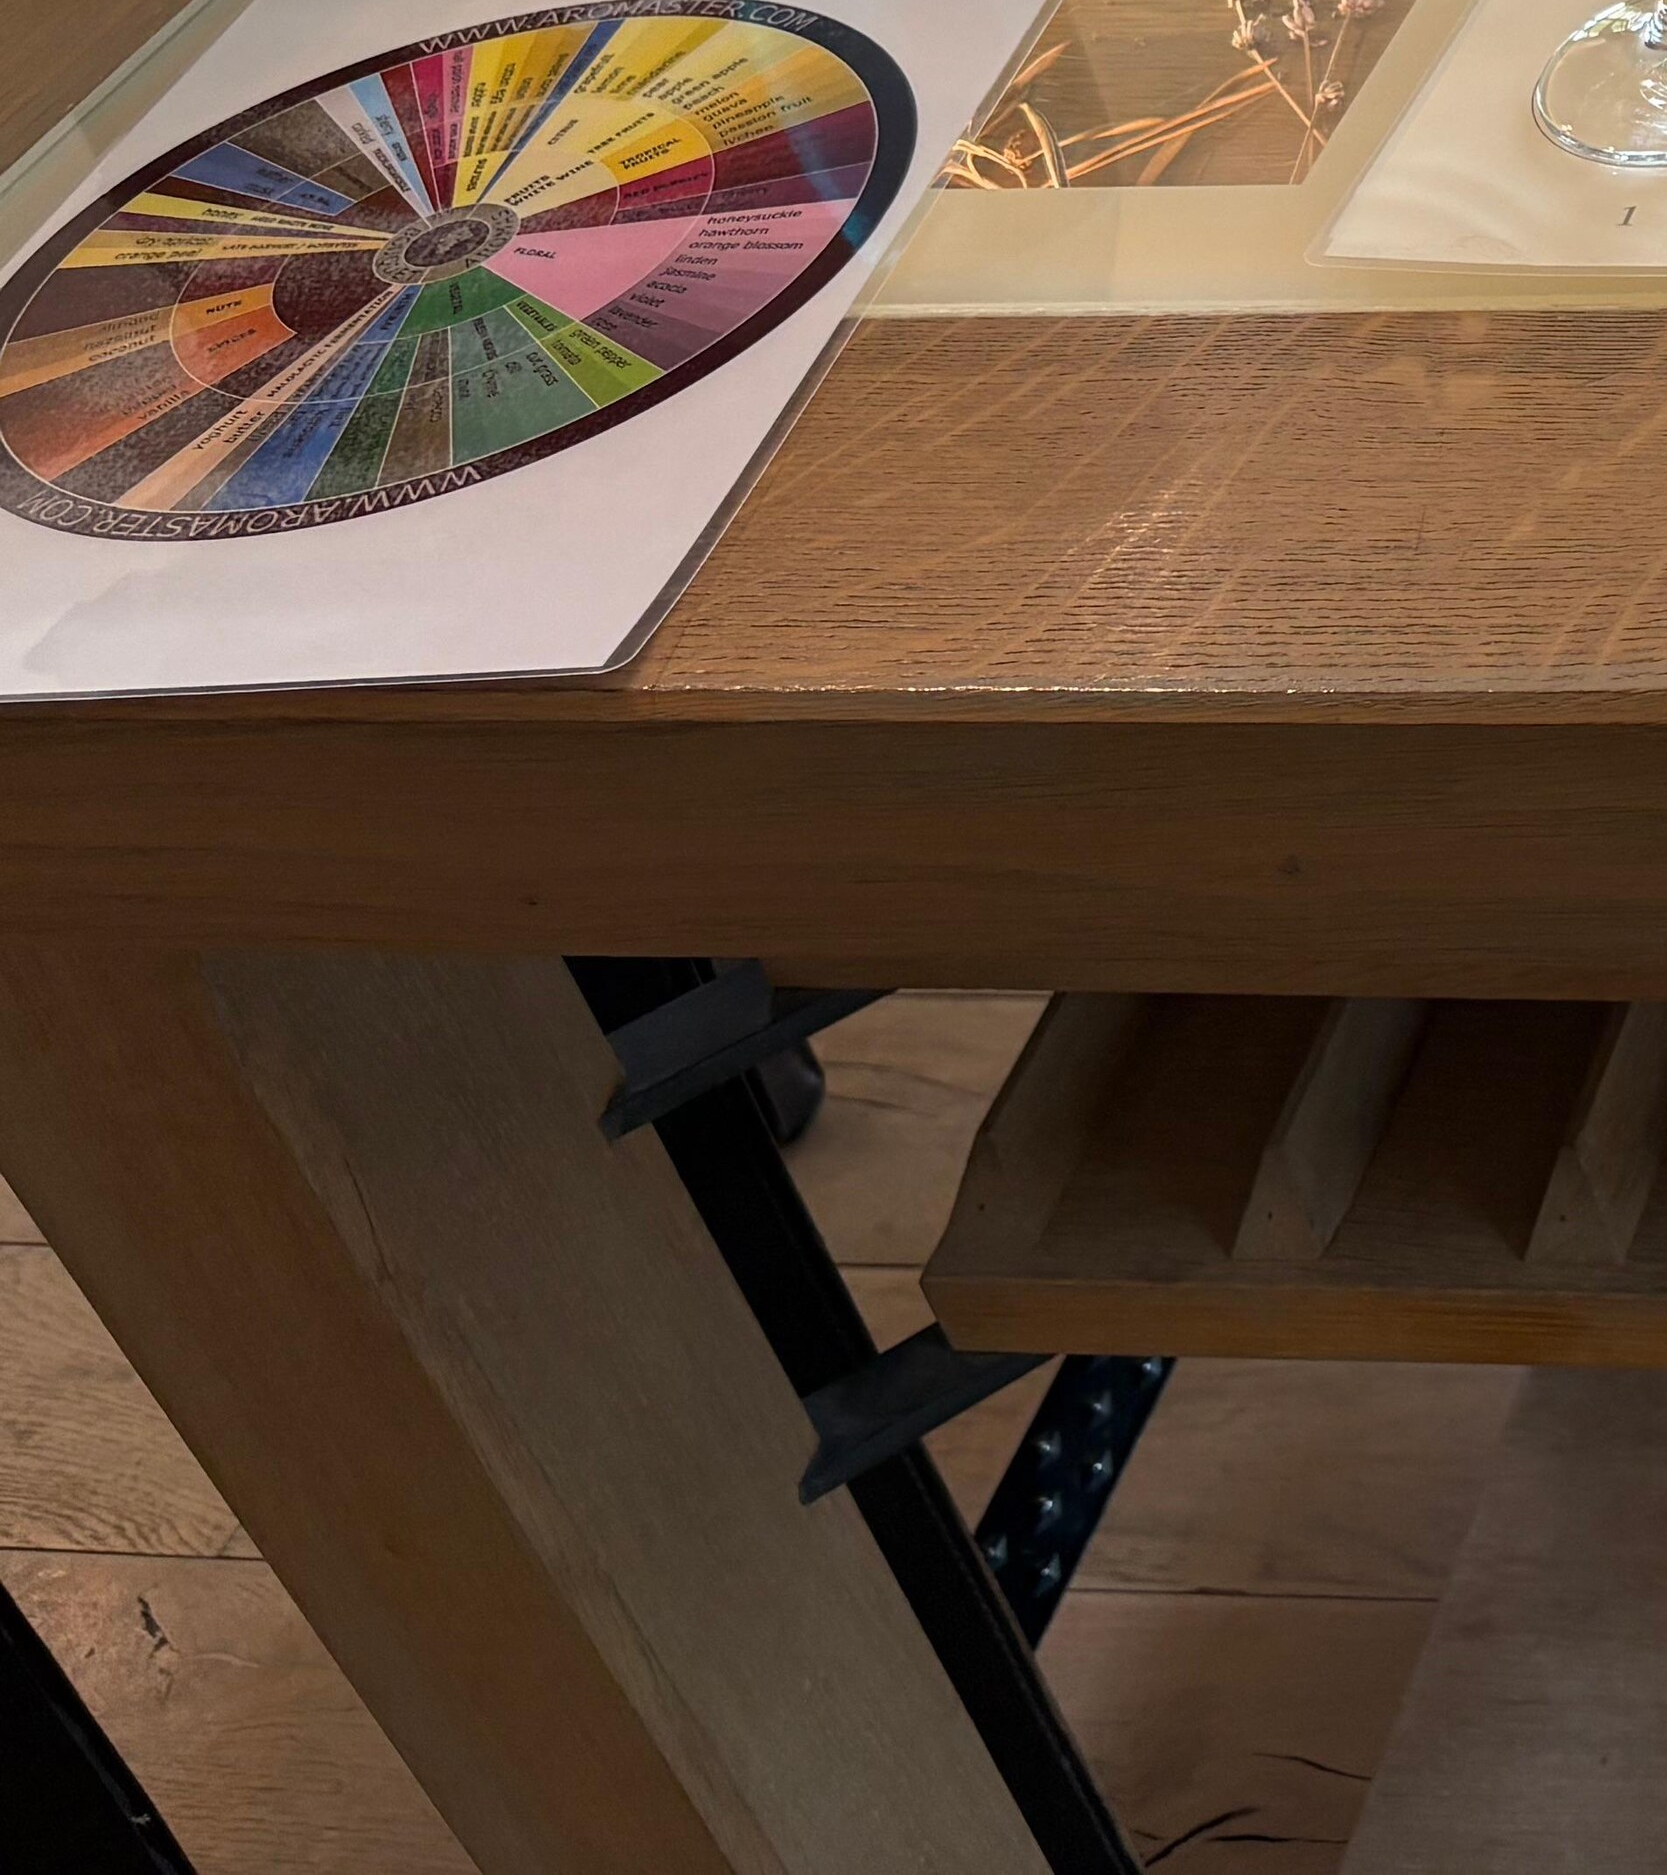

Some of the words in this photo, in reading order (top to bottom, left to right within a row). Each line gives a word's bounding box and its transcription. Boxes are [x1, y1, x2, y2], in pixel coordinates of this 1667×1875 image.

[694, 91, 740, 116] melon
[615, 112, 655, 137] FRUITS
[556, 159, 594, 181] WINE
[707, 209, 803, 225] honeysuckle
[1618, 203, 1638, 228] 1
[698, 226, 769, 238] hawthorn
[513, 247, 556, 259] FLORAL
[742, 241, 804, 251] blossom
[191, 409, 249, 451] yoghurt
[223, 411, 266, 444] butter
[16, 465, 481, 539] WWW.AROMASTER.COM
